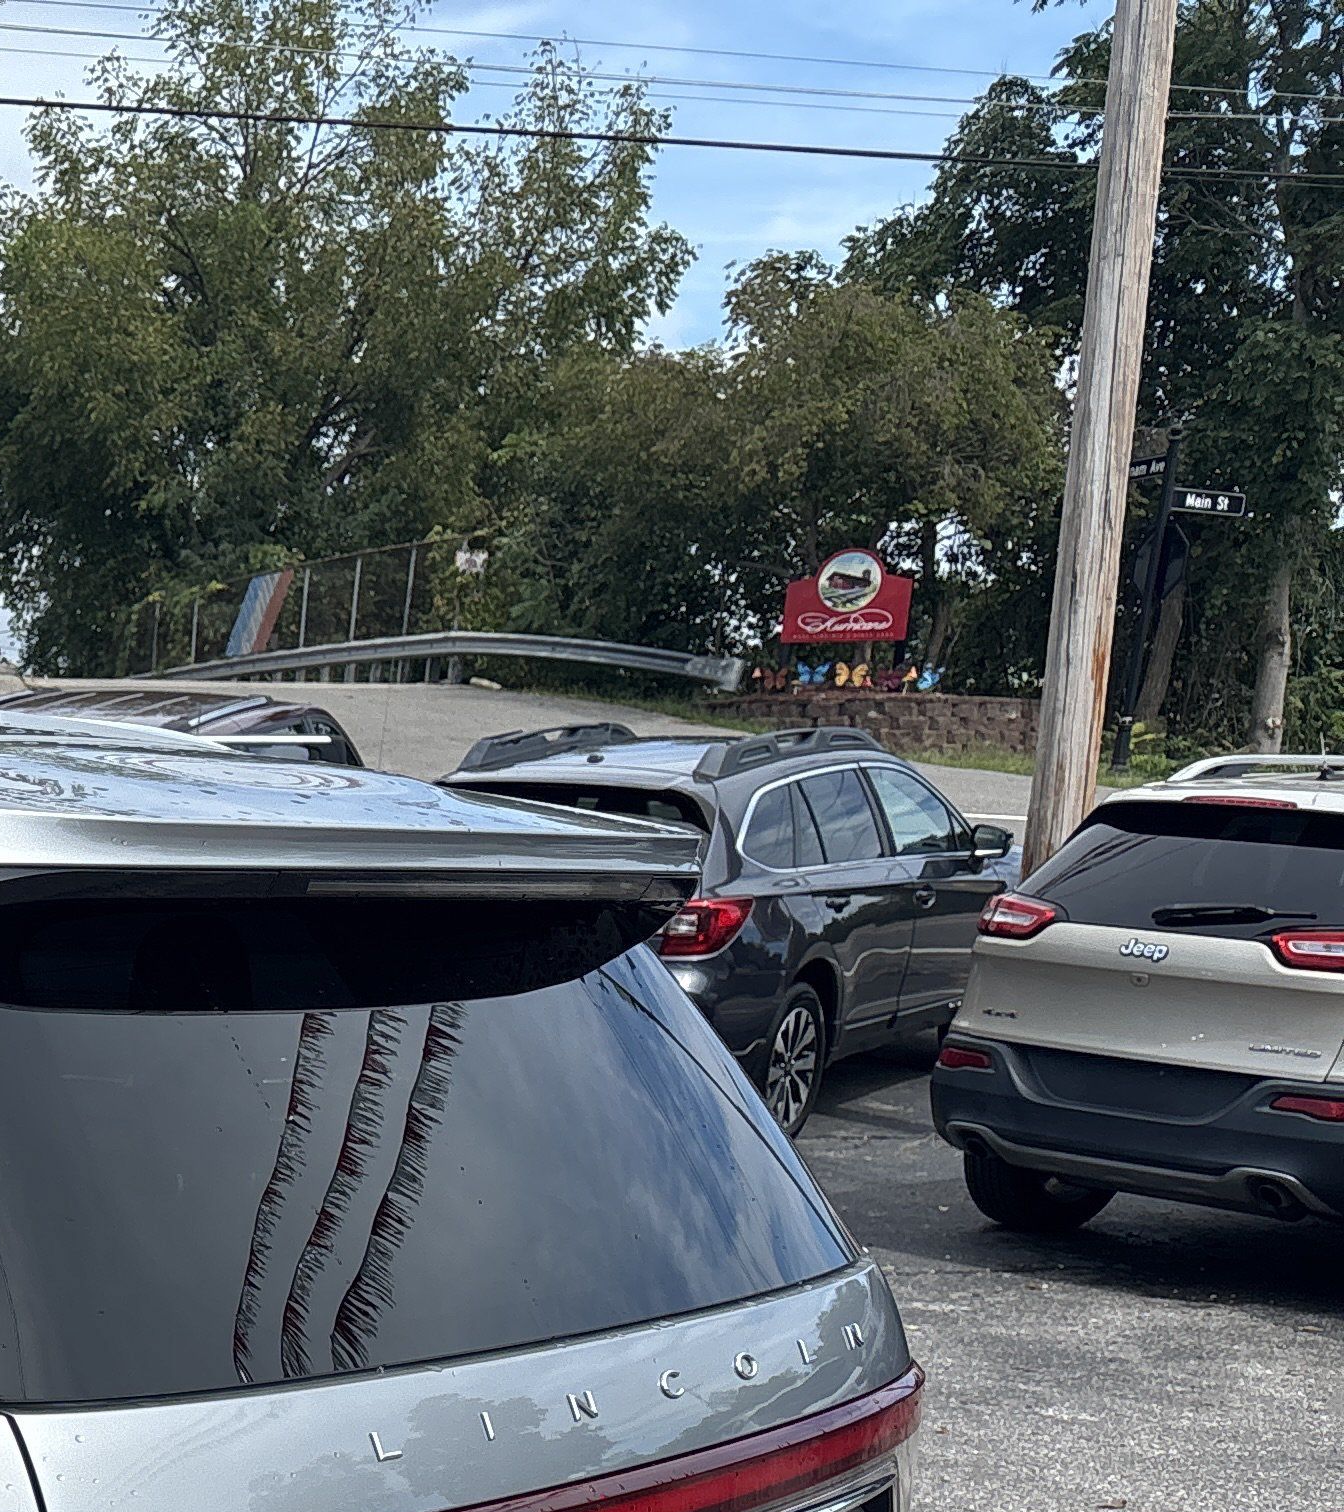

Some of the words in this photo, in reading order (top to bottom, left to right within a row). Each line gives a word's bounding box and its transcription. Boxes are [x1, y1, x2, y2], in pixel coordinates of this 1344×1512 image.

[1185, 493, 1212, 509] Main
[1216, 495, 1230, 511] St
[1120, 938, 1170, 963] Jeep
[368, 1321, 865, 1463] LINCOLN
